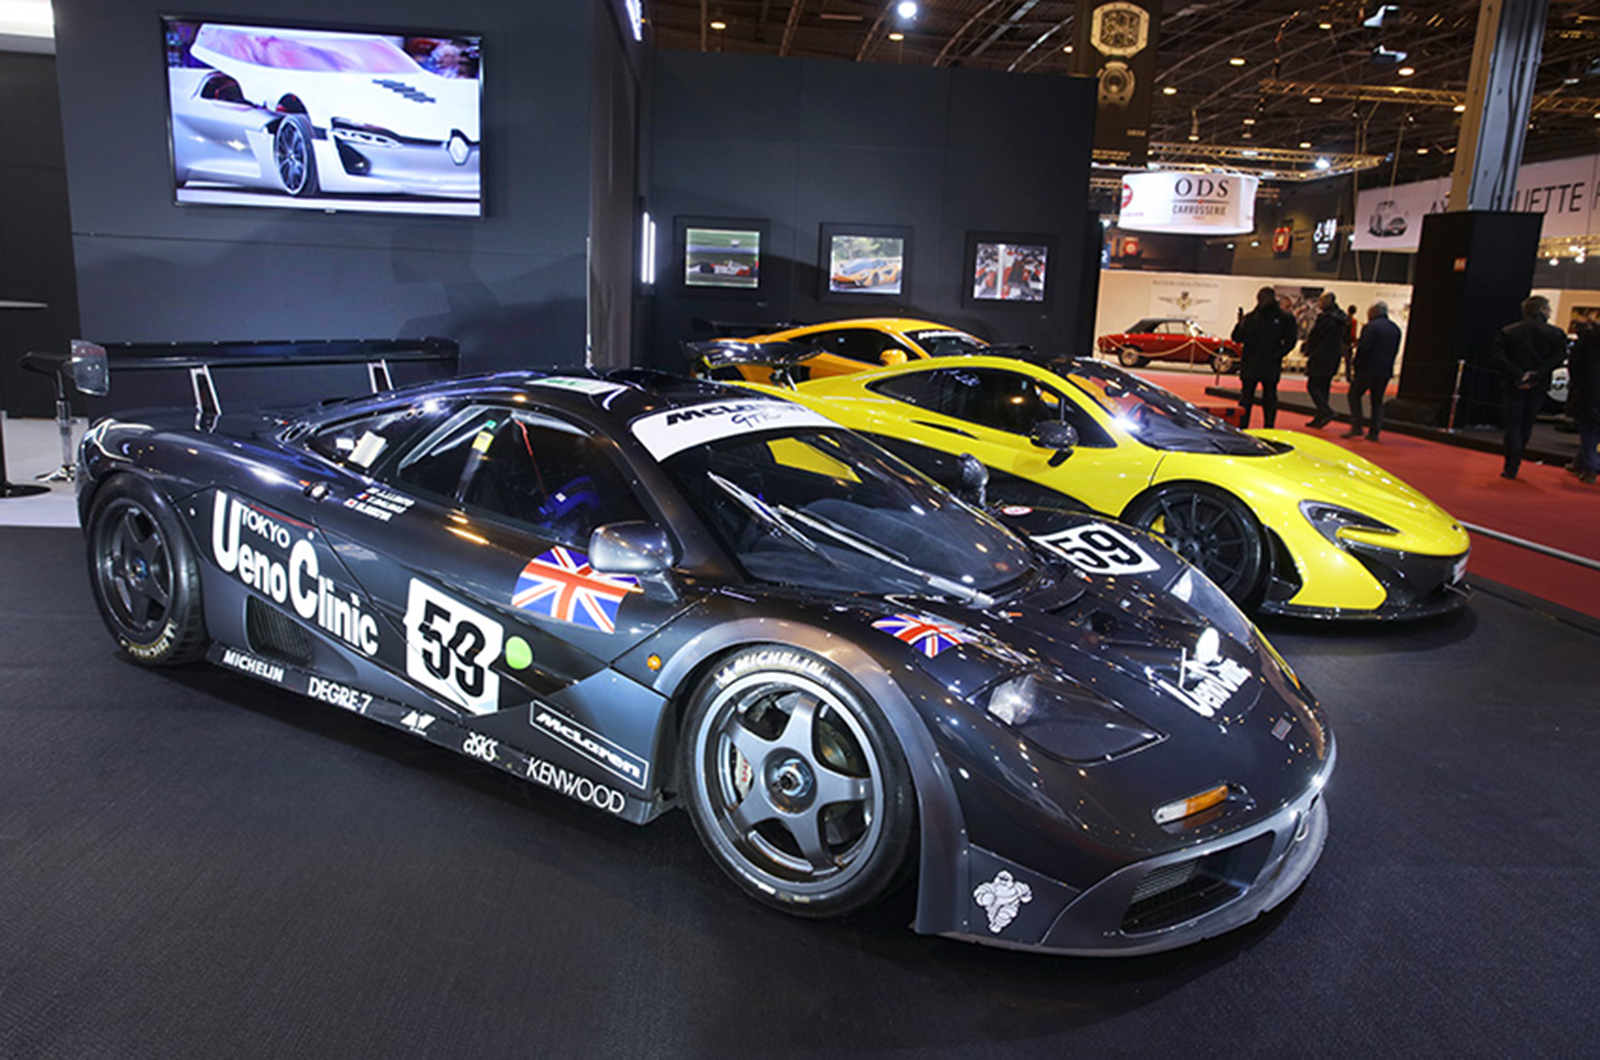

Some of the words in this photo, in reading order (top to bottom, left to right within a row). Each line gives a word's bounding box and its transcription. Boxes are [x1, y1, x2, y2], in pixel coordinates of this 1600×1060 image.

[1174, 178, 1229, 198] ODS
[241, 504, 291, 549] TOKYO
[1042, 529, 1143, 569] 59
[212, 489, 288, 604] Ueno
[289, 539, 379, 656] Clinic
[222, 649, 285, 683] MICHELIN
[417, 598, 487, 699] 59
[535, 712, 642, 779] McLaren
[526, 756, 625, 814] KENWOOD
